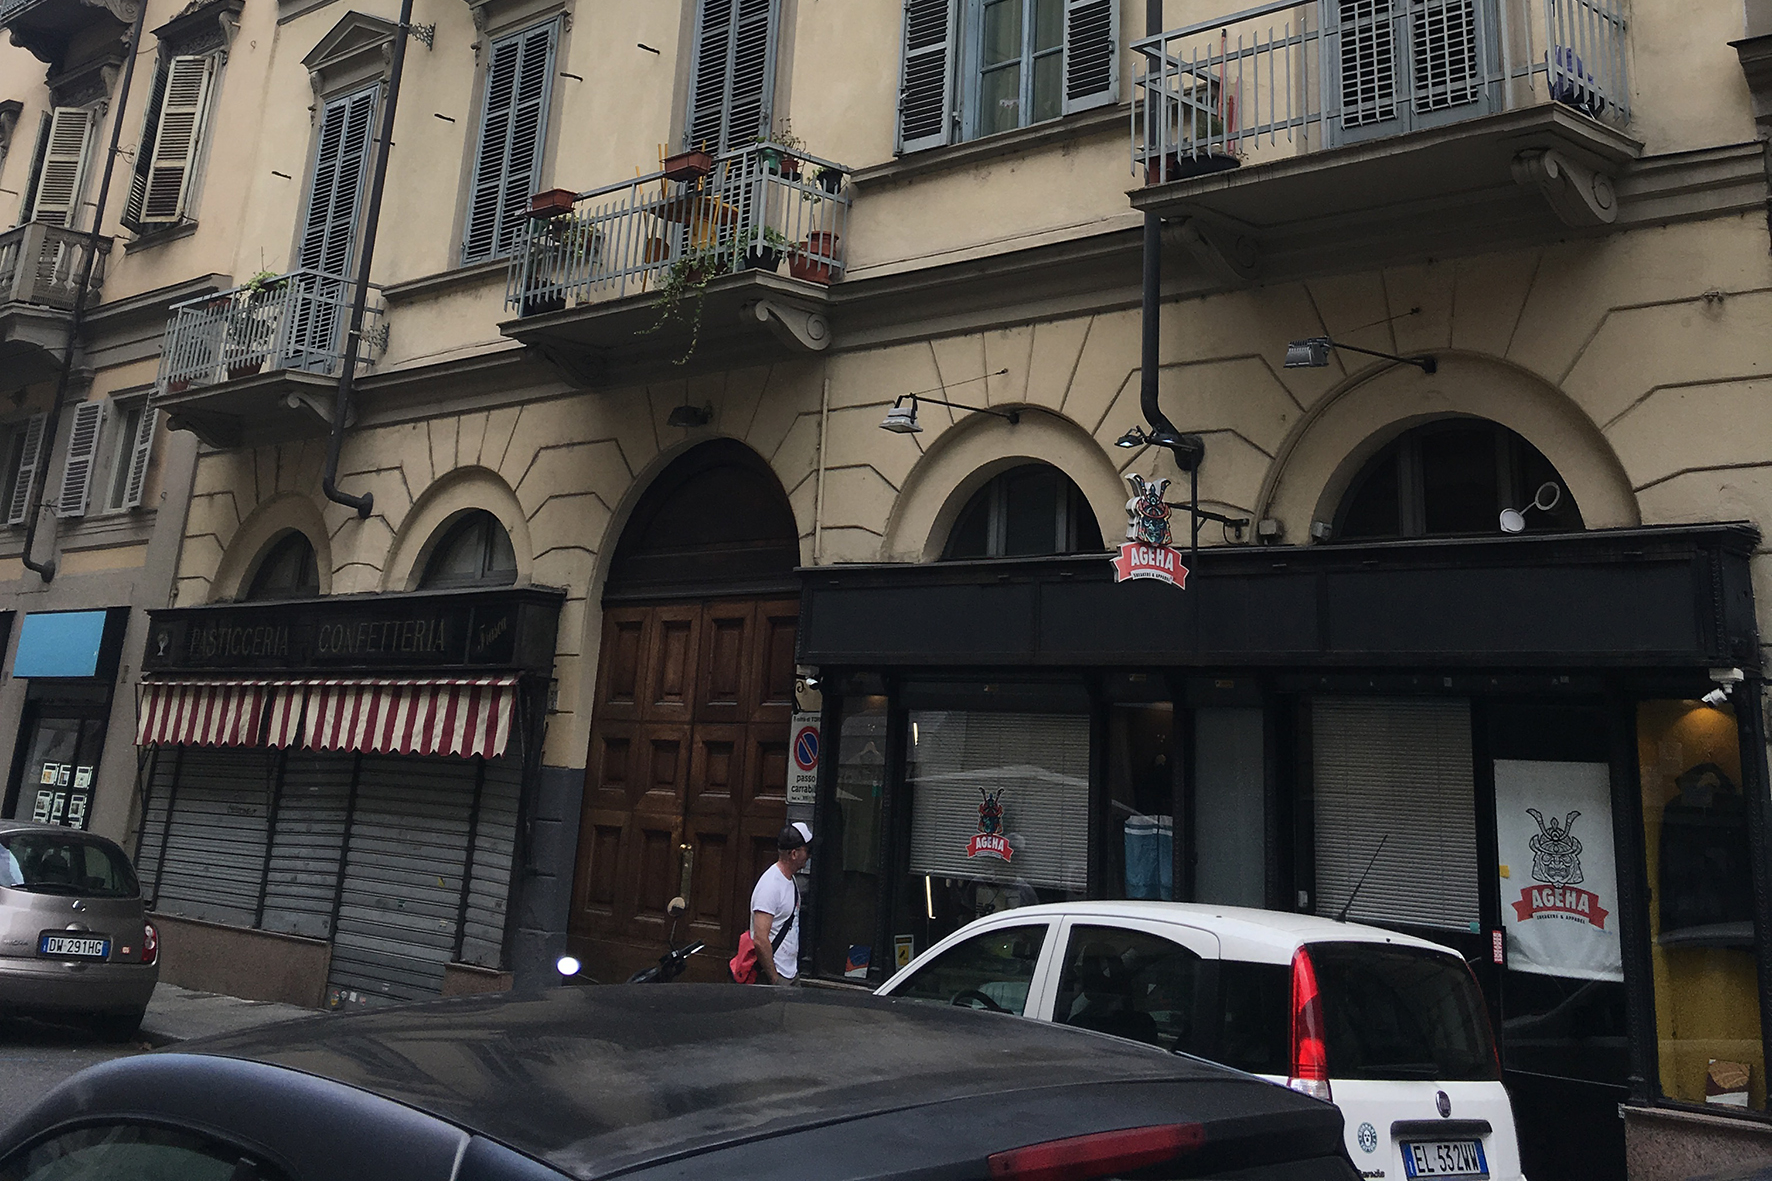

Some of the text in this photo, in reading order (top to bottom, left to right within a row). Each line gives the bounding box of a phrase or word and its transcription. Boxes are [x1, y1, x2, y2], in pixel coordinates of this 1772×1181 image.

[1131, 546, 1174, 571] AGEHA
[189, 619, 445, 656] PASTICCERIA CONFETTERIA
[796, 775, 816, 783] passo
[976, 836, 1004, 852] AGEHA
[1532, 888, 1590, 914] AGEHA
[49, 938, 102, 955] DW 291HG
[1413, 1145, 1435, 1173] EL
[1437, 1143, 1479, 1173] 532WW
